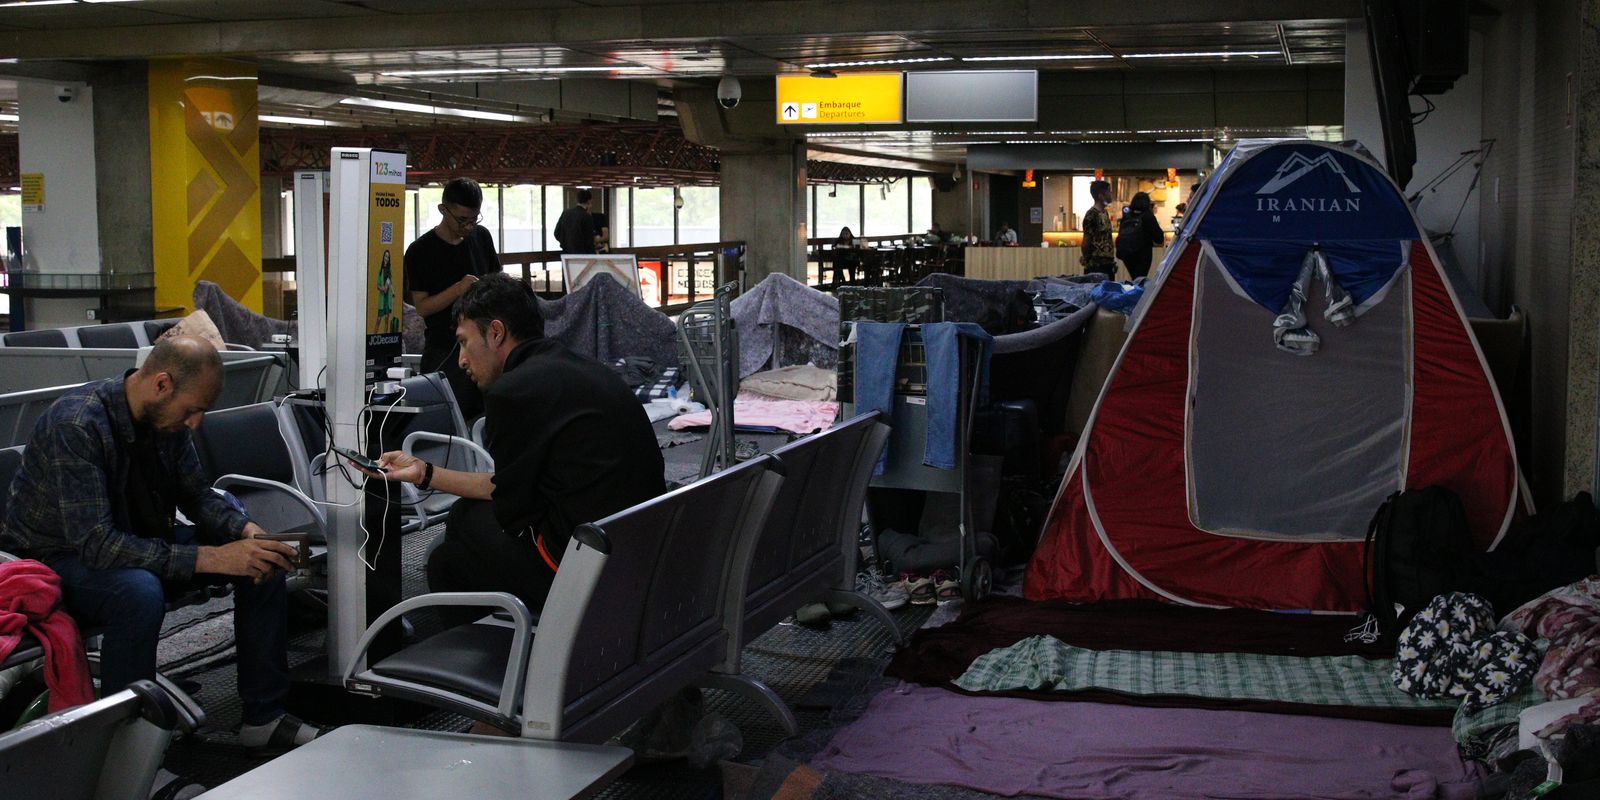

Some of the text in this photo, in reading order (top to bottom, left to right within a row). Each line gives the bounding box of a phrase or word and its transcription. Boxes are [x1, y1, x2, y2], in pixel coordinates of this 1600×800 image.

[820, 101, 861, 109] Embarque
[820, 110, 865, 119] Departures
[375, 197, 400, 208] TODOS
[1256, 198, 1361, 212] IRANIAN
[1272, 215, 1281, 223] M
[369, 335, 400, 346] JCDecaux
